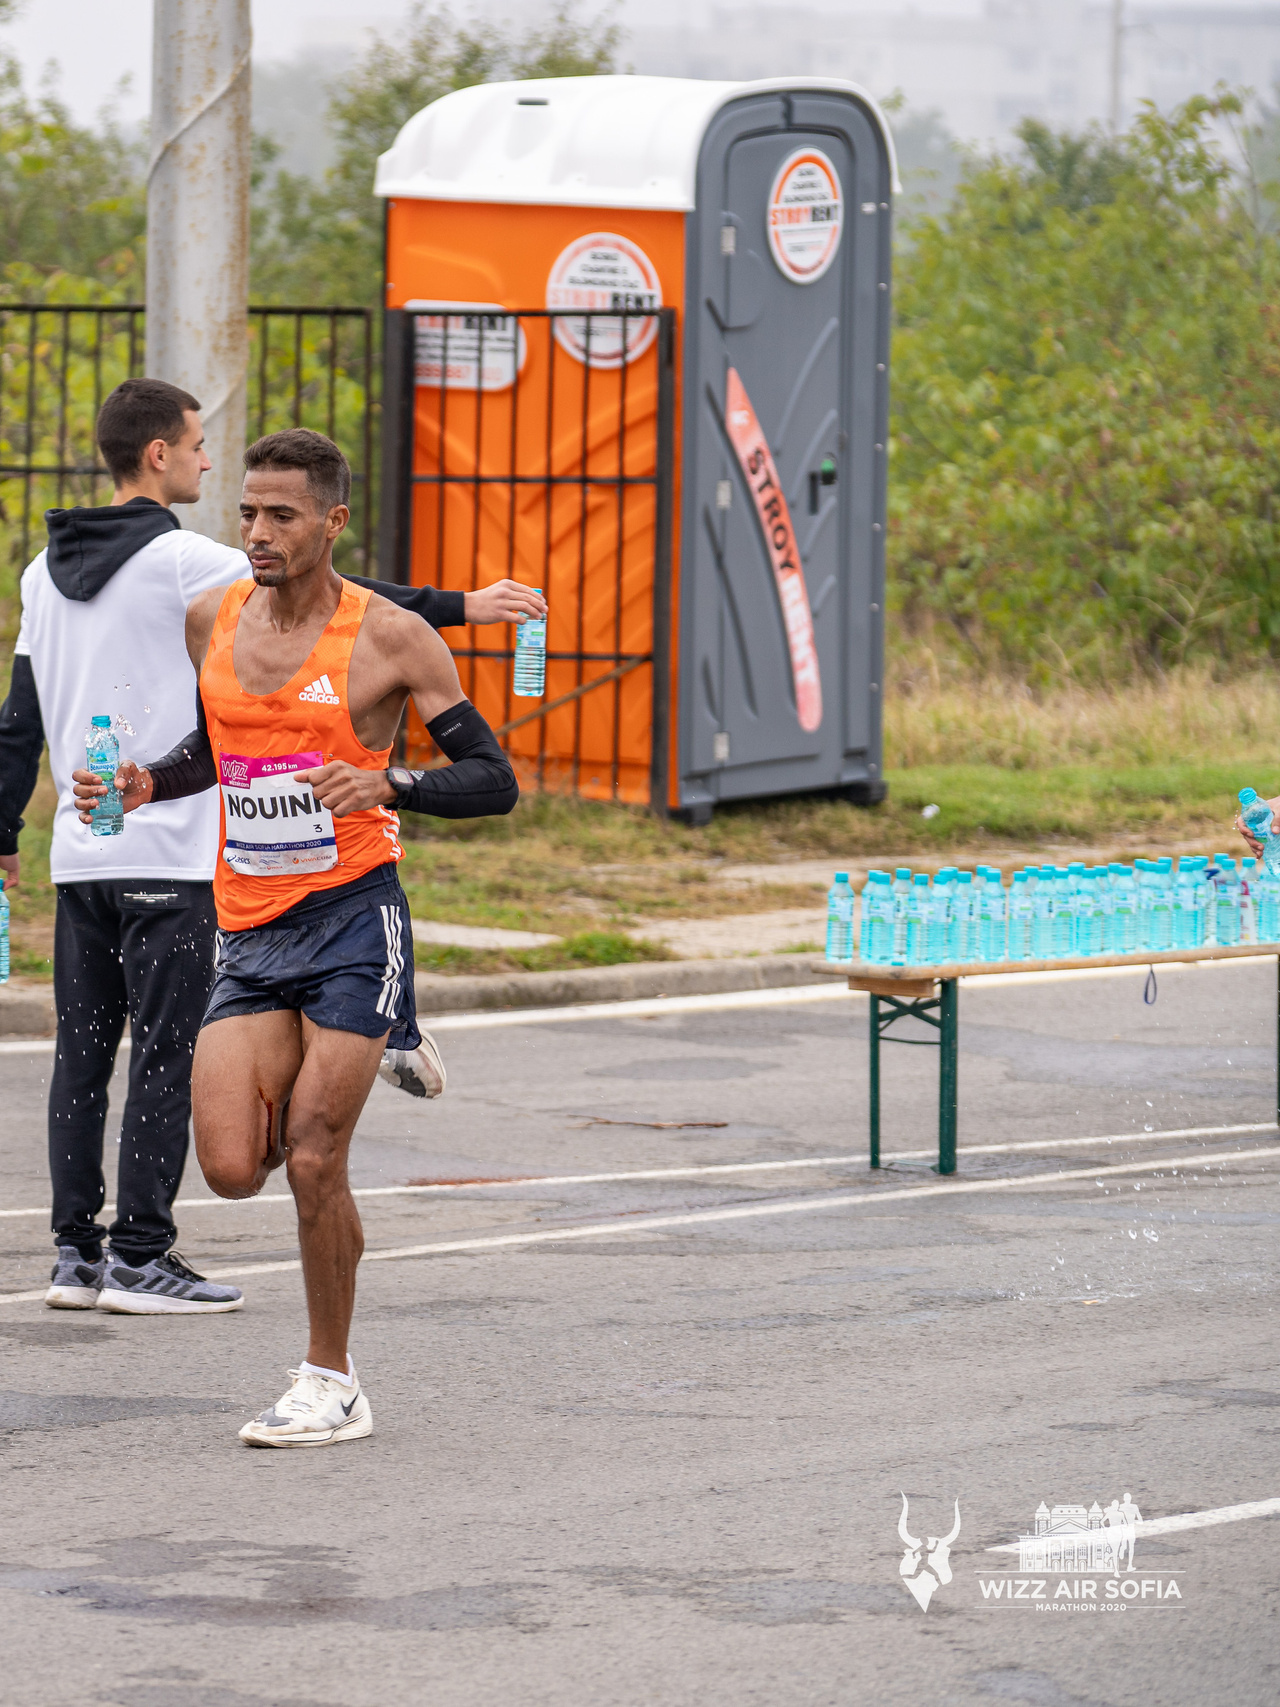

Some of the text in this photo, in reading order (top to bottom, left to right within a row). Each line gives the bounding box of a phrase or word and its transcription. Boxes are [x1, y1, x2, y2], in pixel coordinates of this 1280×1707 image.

[299, 691, 340, 705] adidas
[261, 762, 288, 772] 42.195
[227, 792, 322, 819] NOUINI
[313, 824, 323, 833] 3
[271, 842, 305, 850] MARATHON
